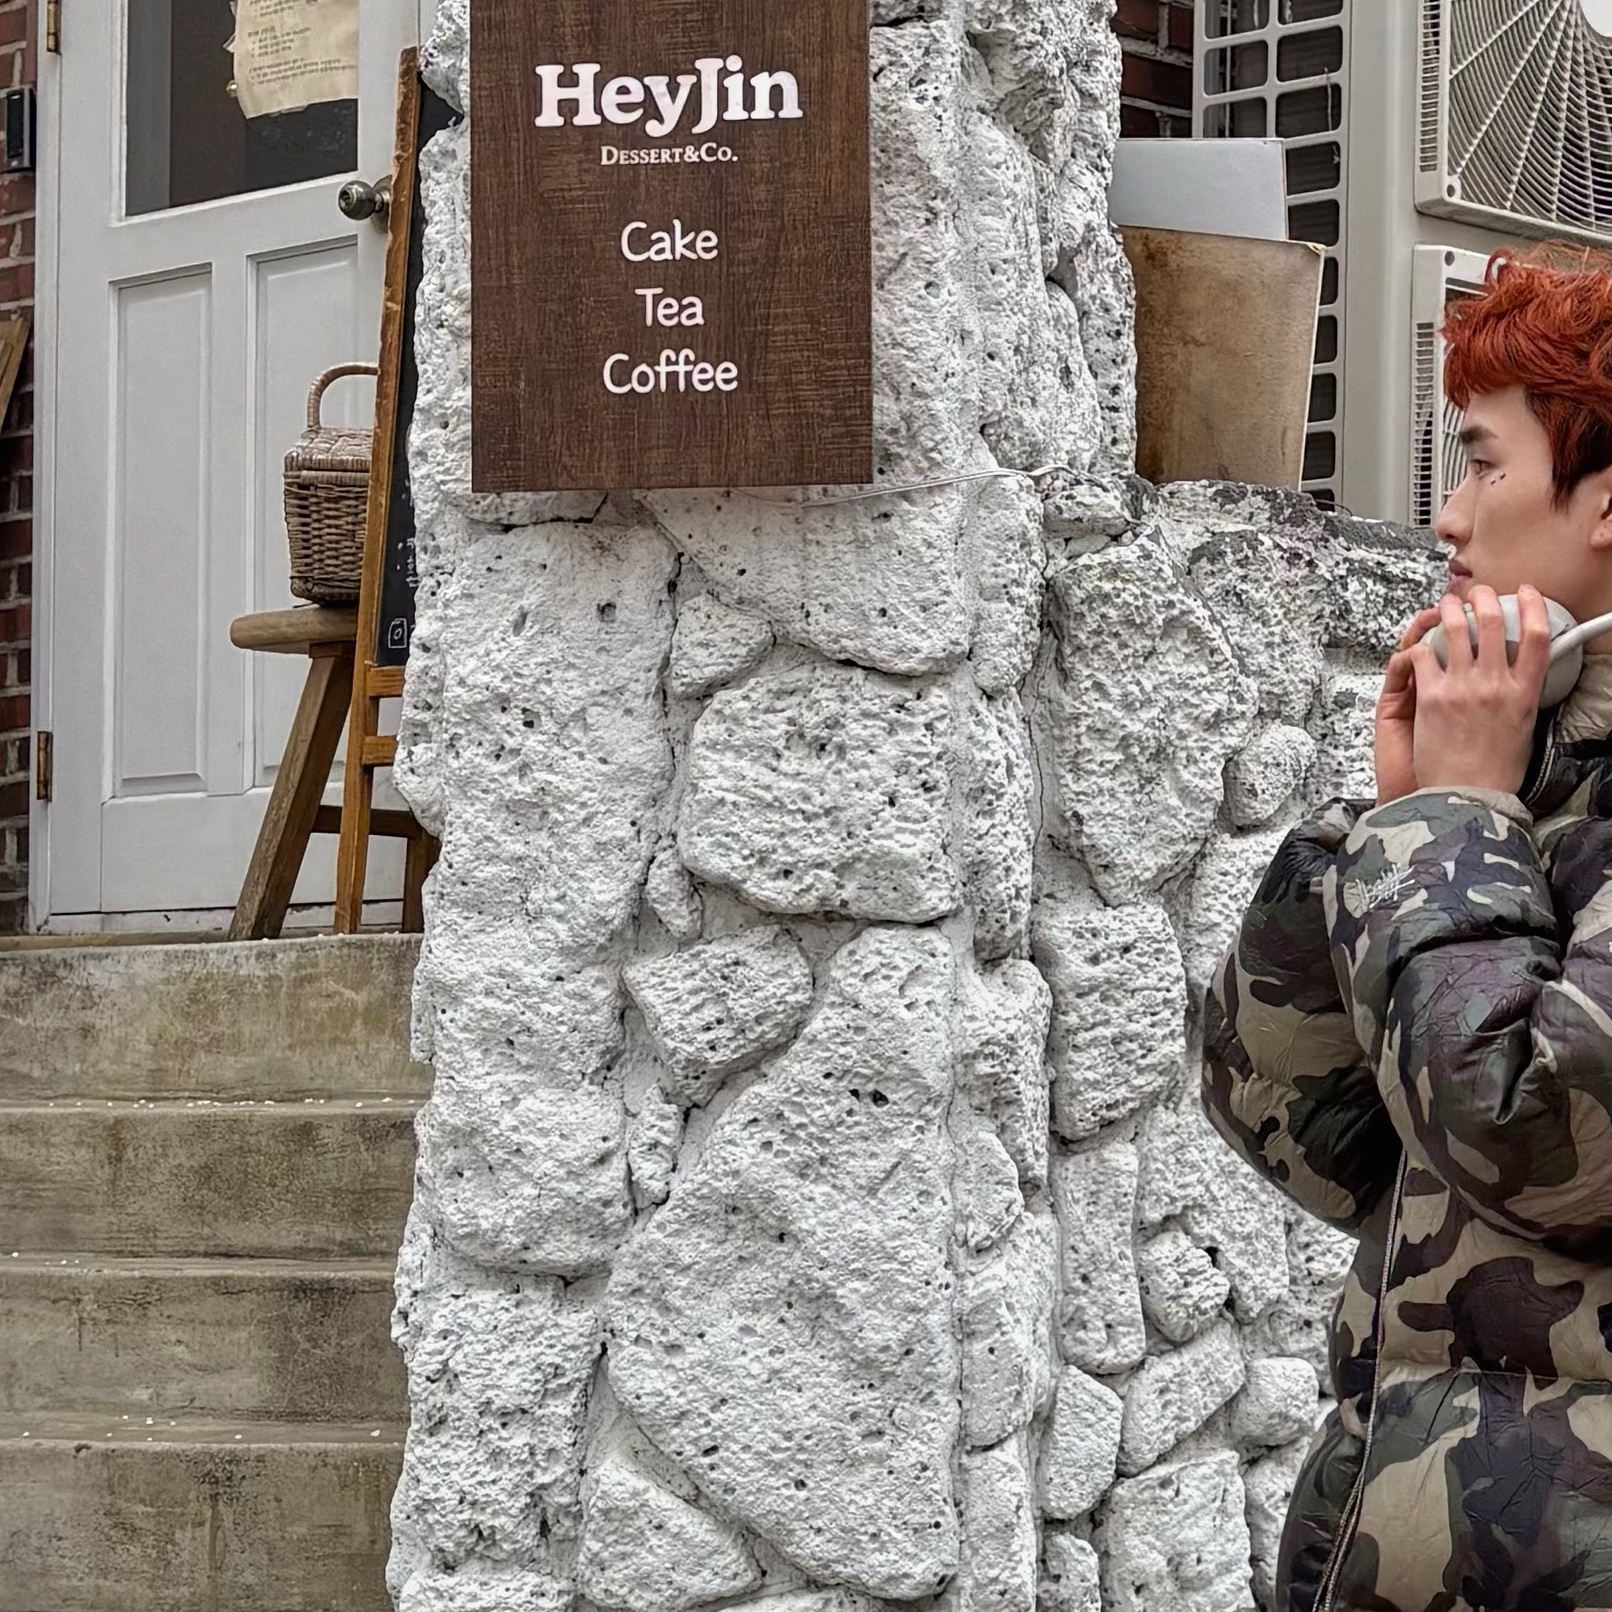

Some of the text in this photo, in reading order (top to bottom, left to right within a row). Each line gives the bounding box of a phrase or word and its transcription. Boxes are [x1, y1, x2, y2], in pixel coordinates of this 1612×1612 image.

[534, 54, 803, 138] HeyJin
[620, 218, 719, 262] Cake
[634, 287, 705, 327] Tea
[602, 348, 739, 394] Coffee
